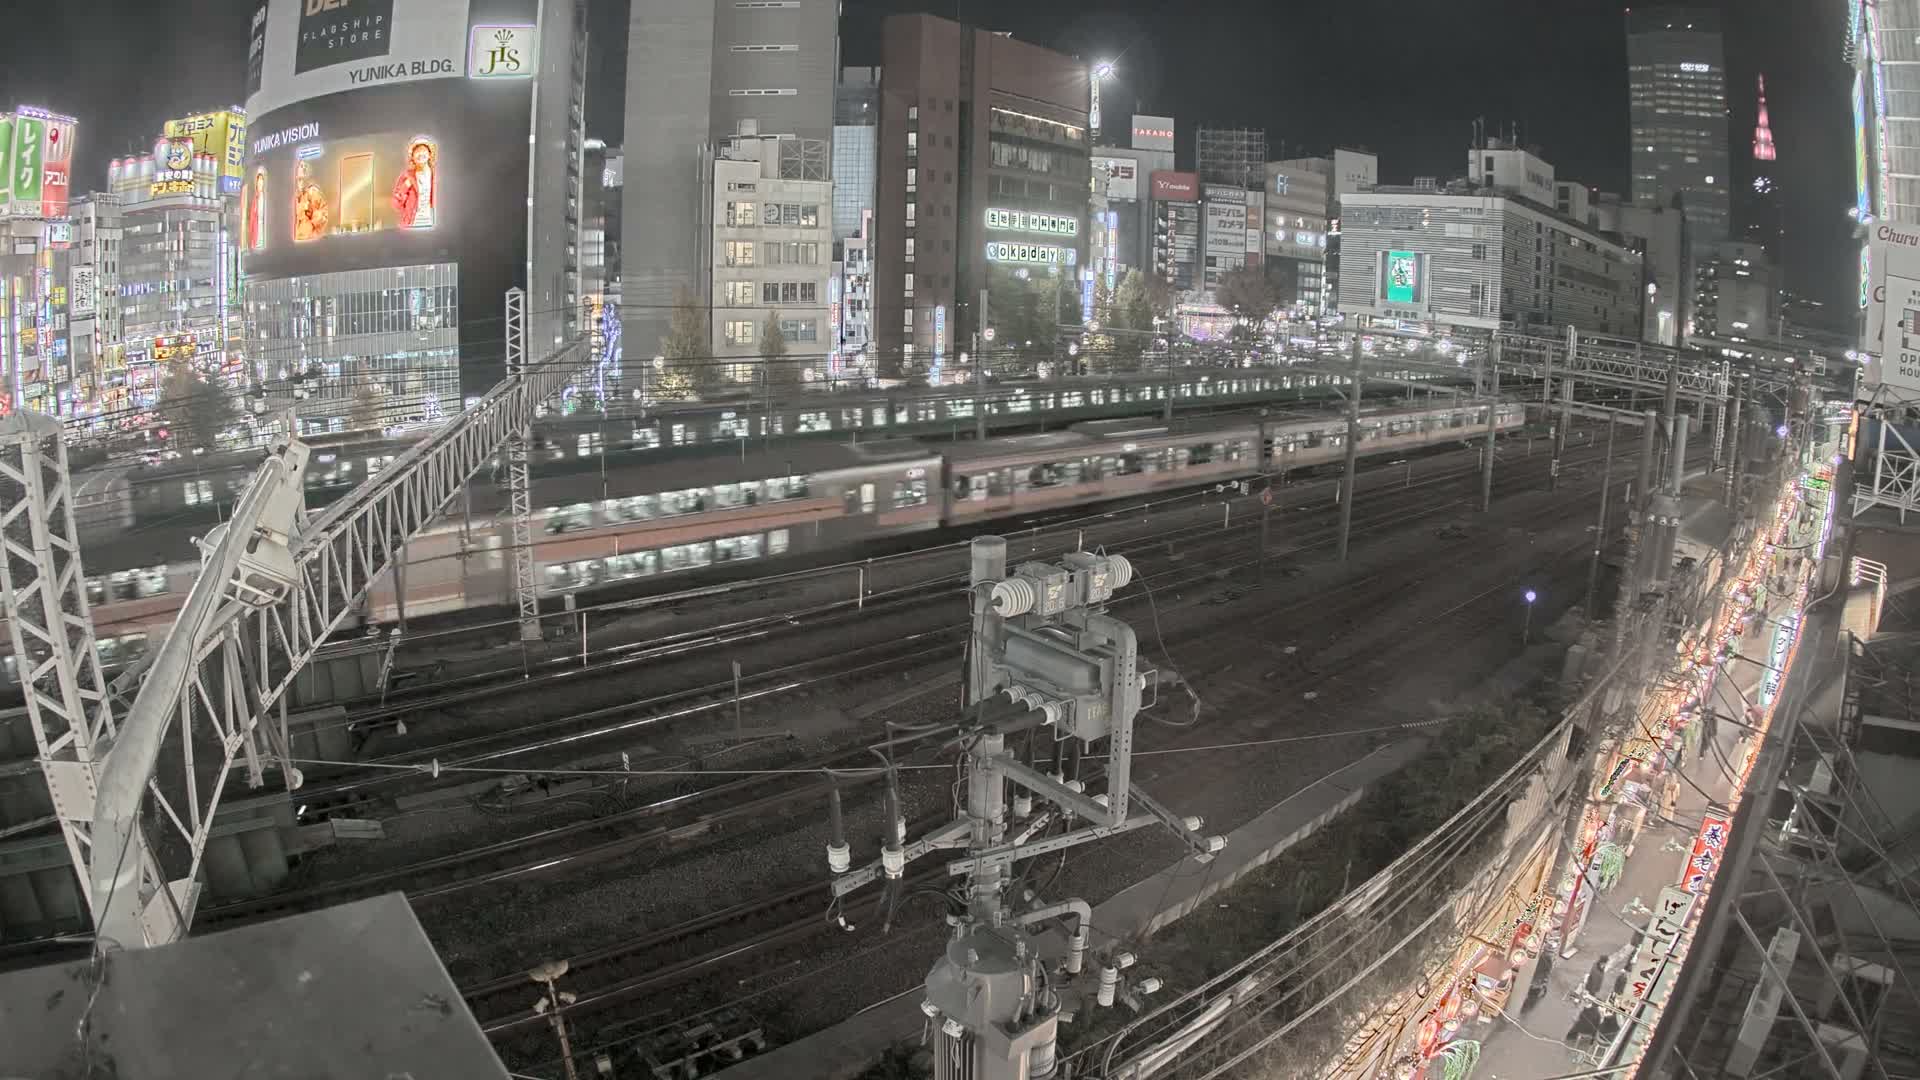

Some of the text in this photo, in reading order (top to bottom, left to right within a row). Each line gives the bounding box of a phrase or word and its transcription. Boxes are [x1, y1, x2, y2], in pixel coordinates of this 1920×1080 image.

[303, 16, 383, 41] FLAGSHIP
[328, 30, 382, 49] STORE
[349, 59, 455, 84] YUNIKA BLDG.
[254, 122, 319, 154] YUNIKA VISION
[1134, 127, 1174, 137] TAKANO
[20, 122, 36, 191] レイク
[44, 170, 68, 186] アコム
[1209, 207, 1245, 218] ヨドバシ
[1218, 219, 1244, 229] カメラ
[1877, 225, 1919, 246] Churu
[1000, 246, 1065, 262] okadaya
